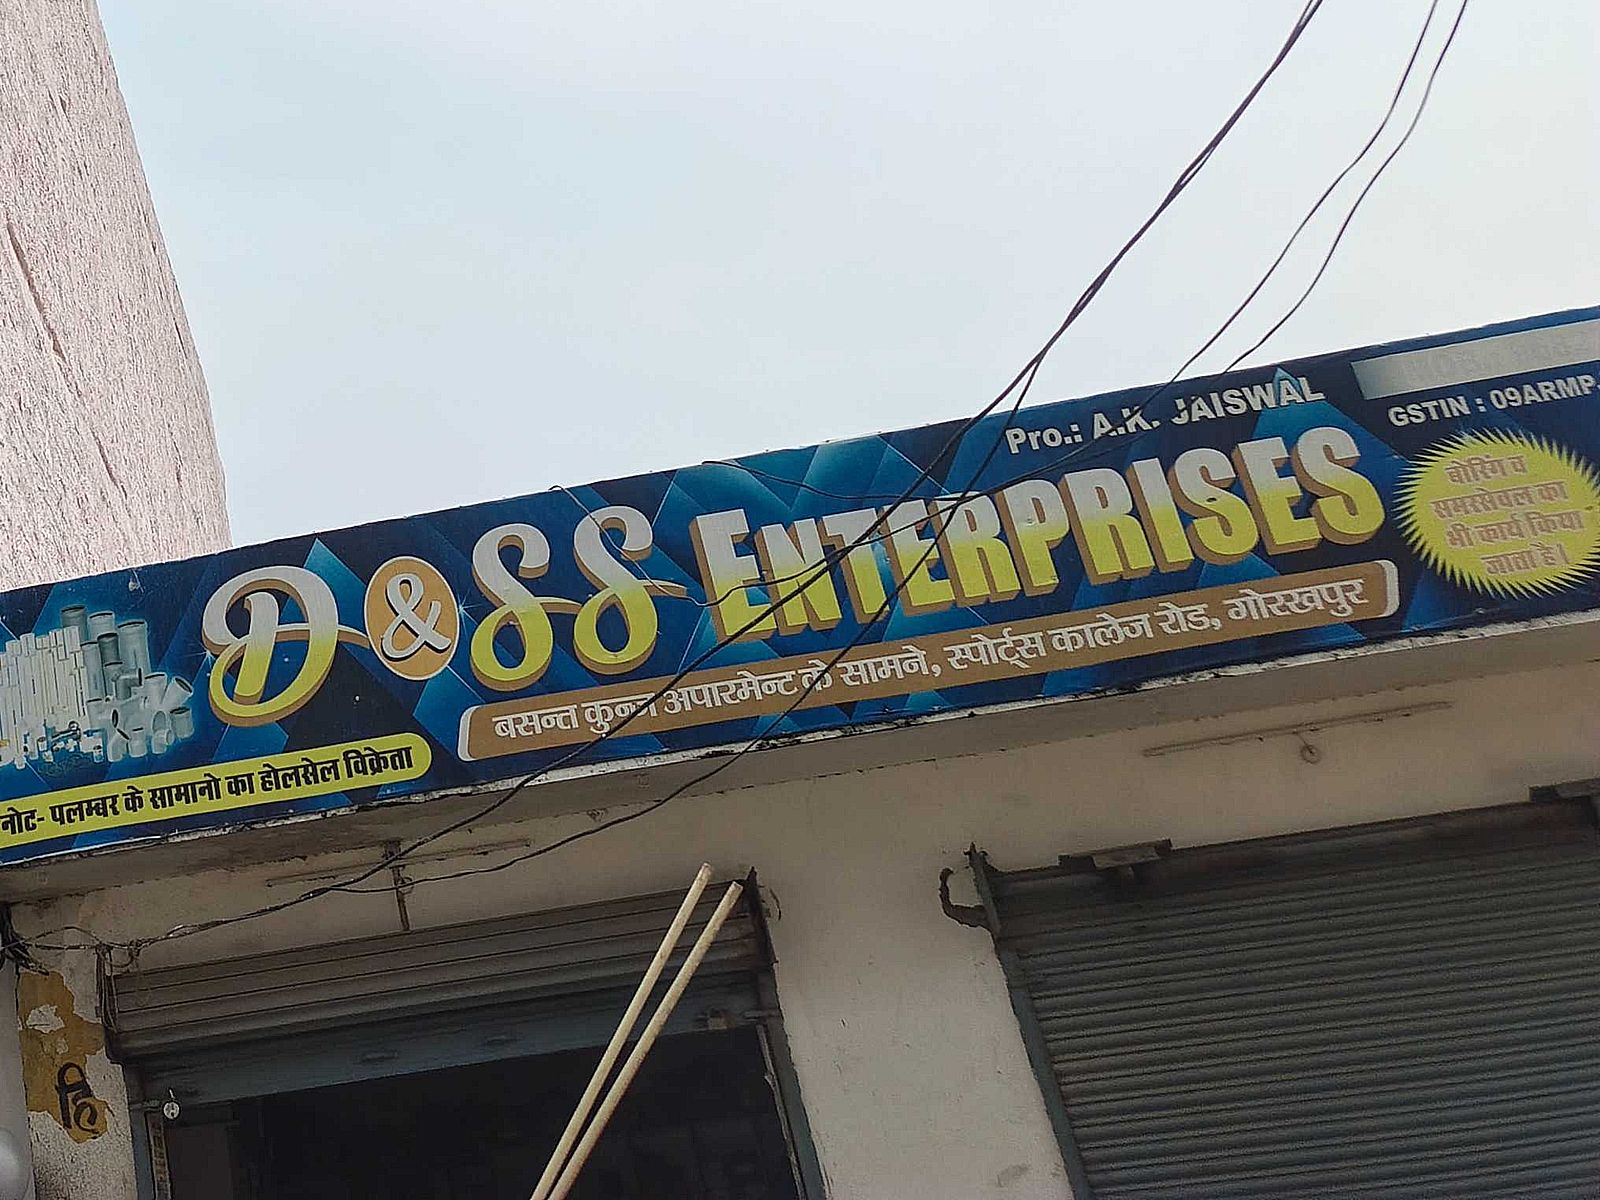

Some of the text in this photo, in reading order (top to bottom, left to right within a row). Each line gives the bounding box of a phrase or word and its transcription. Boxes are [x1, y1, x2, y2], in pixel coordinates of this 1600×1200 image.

[1170, 377, 1325, 425] JAISWAL
[1388, 396, 1471, 427] GSTIN
[1489, 375, 1600, 409] 09ARMP
[690, 426, 1385, 643] ENTERPRISES
[491, 708, 579, 738] बसन्त
[664, 670, 798, 716] अपारमेन्ट
[797, 659, 832, 694] के
[1050, 614, 1154, 651] कालेज
[1223, 578, 1368, 622] गोरखपुर
[49, 792, 120, 827] पलम्बर
[121, 786, 144, 813] के
[147, 772, 224, 810] सामानो
[224, 771, 255, 797] का
[257, 757, 340, 792] होलसेल
[343, 745, 414, 779] विक्रेता
